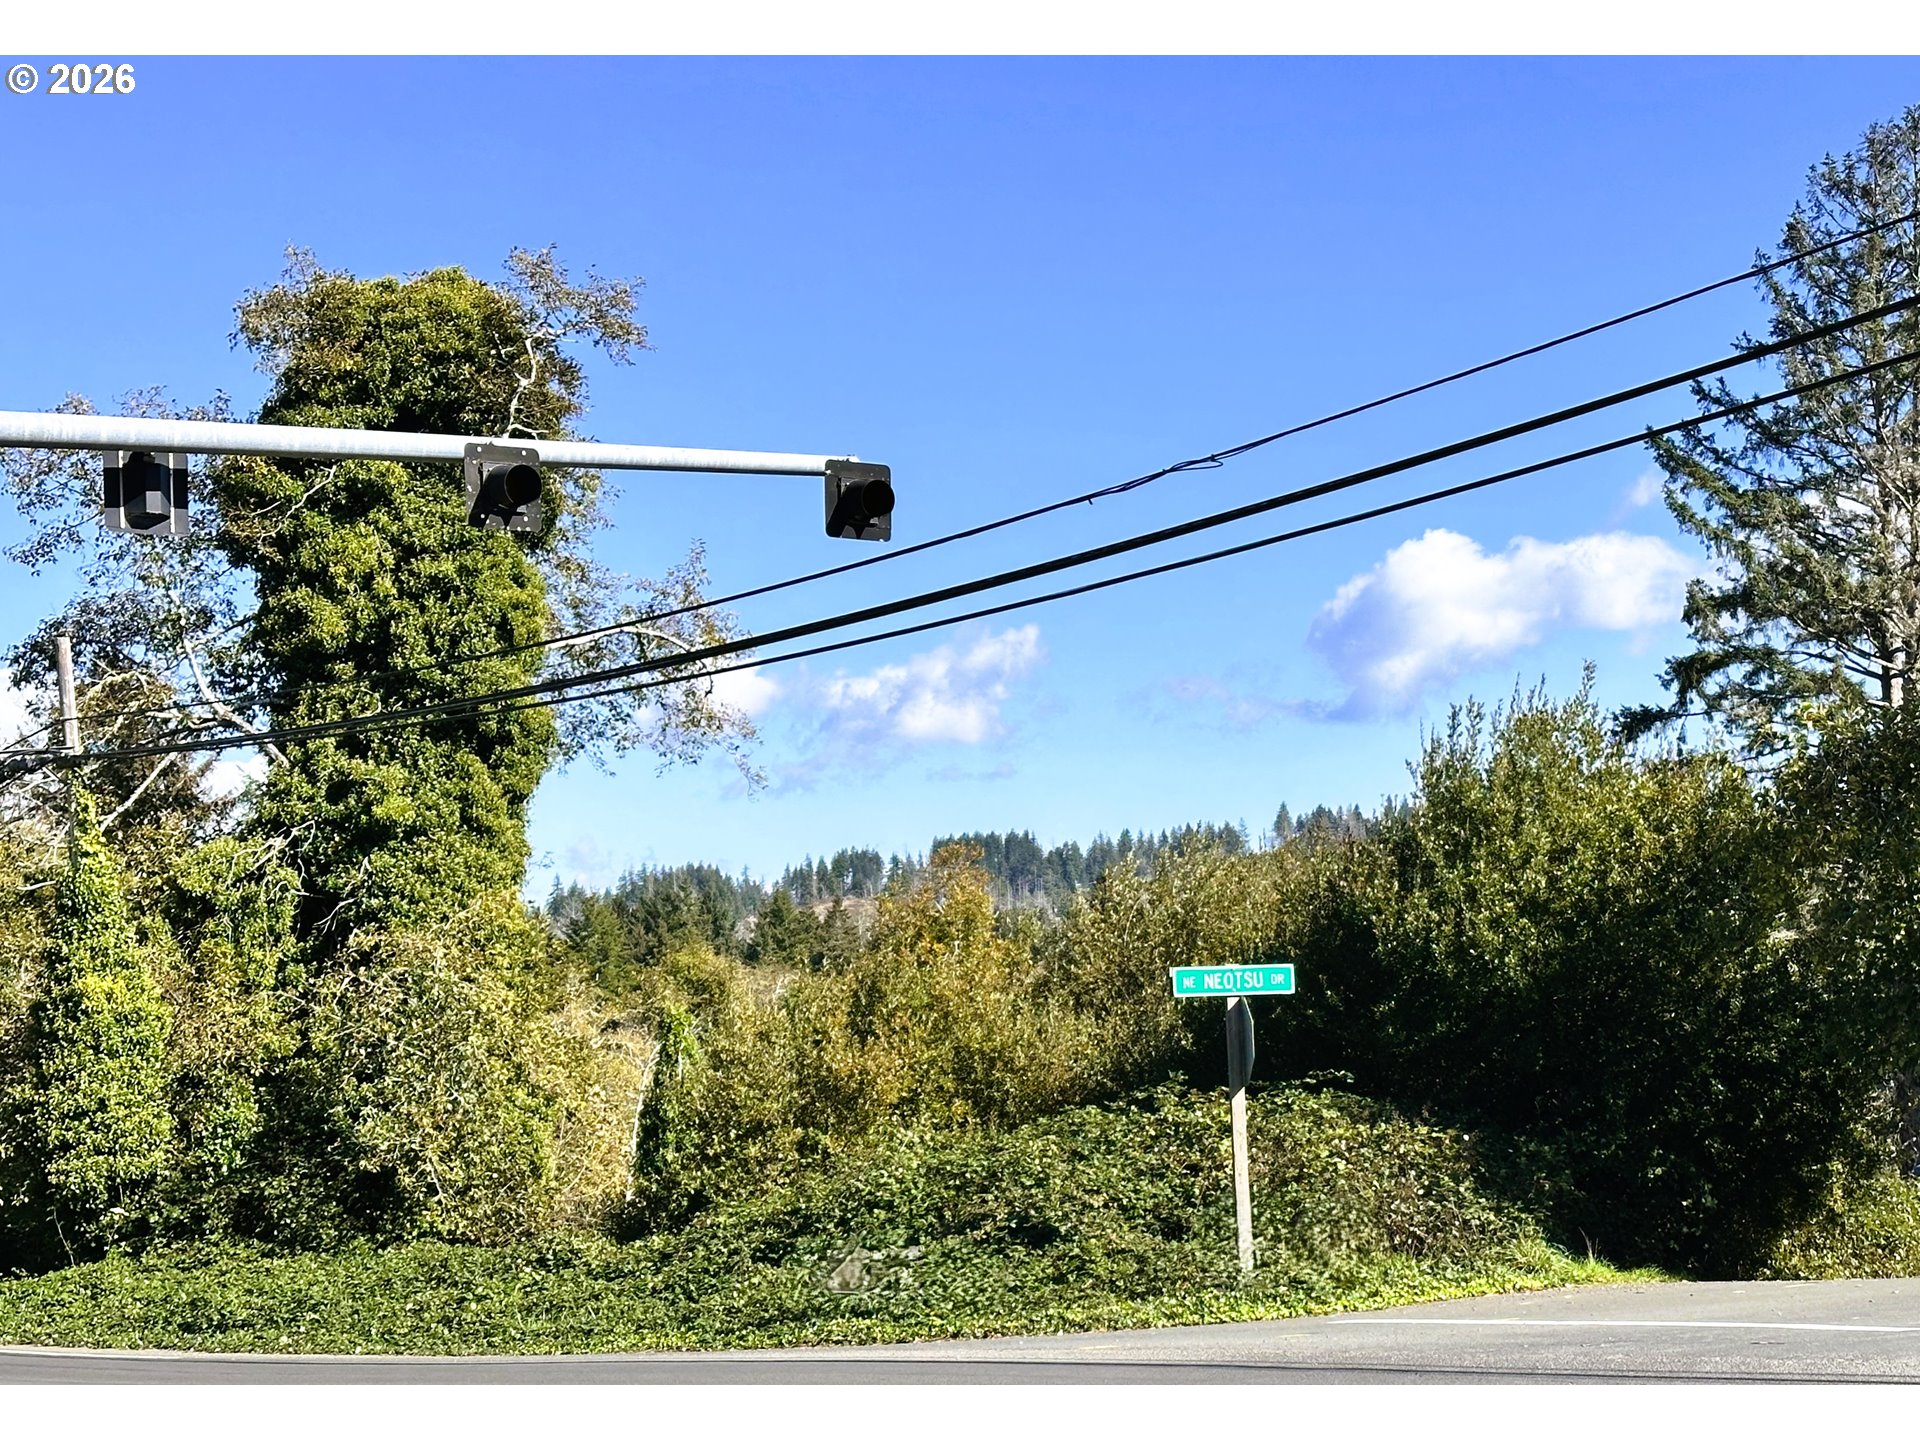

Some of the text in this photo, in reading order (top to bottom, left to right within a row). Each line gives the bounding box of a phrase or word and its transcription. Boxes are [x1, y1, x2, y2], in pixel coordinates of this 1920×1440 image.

[1182, 971, 1285, 990] NE NEOTSU DR
